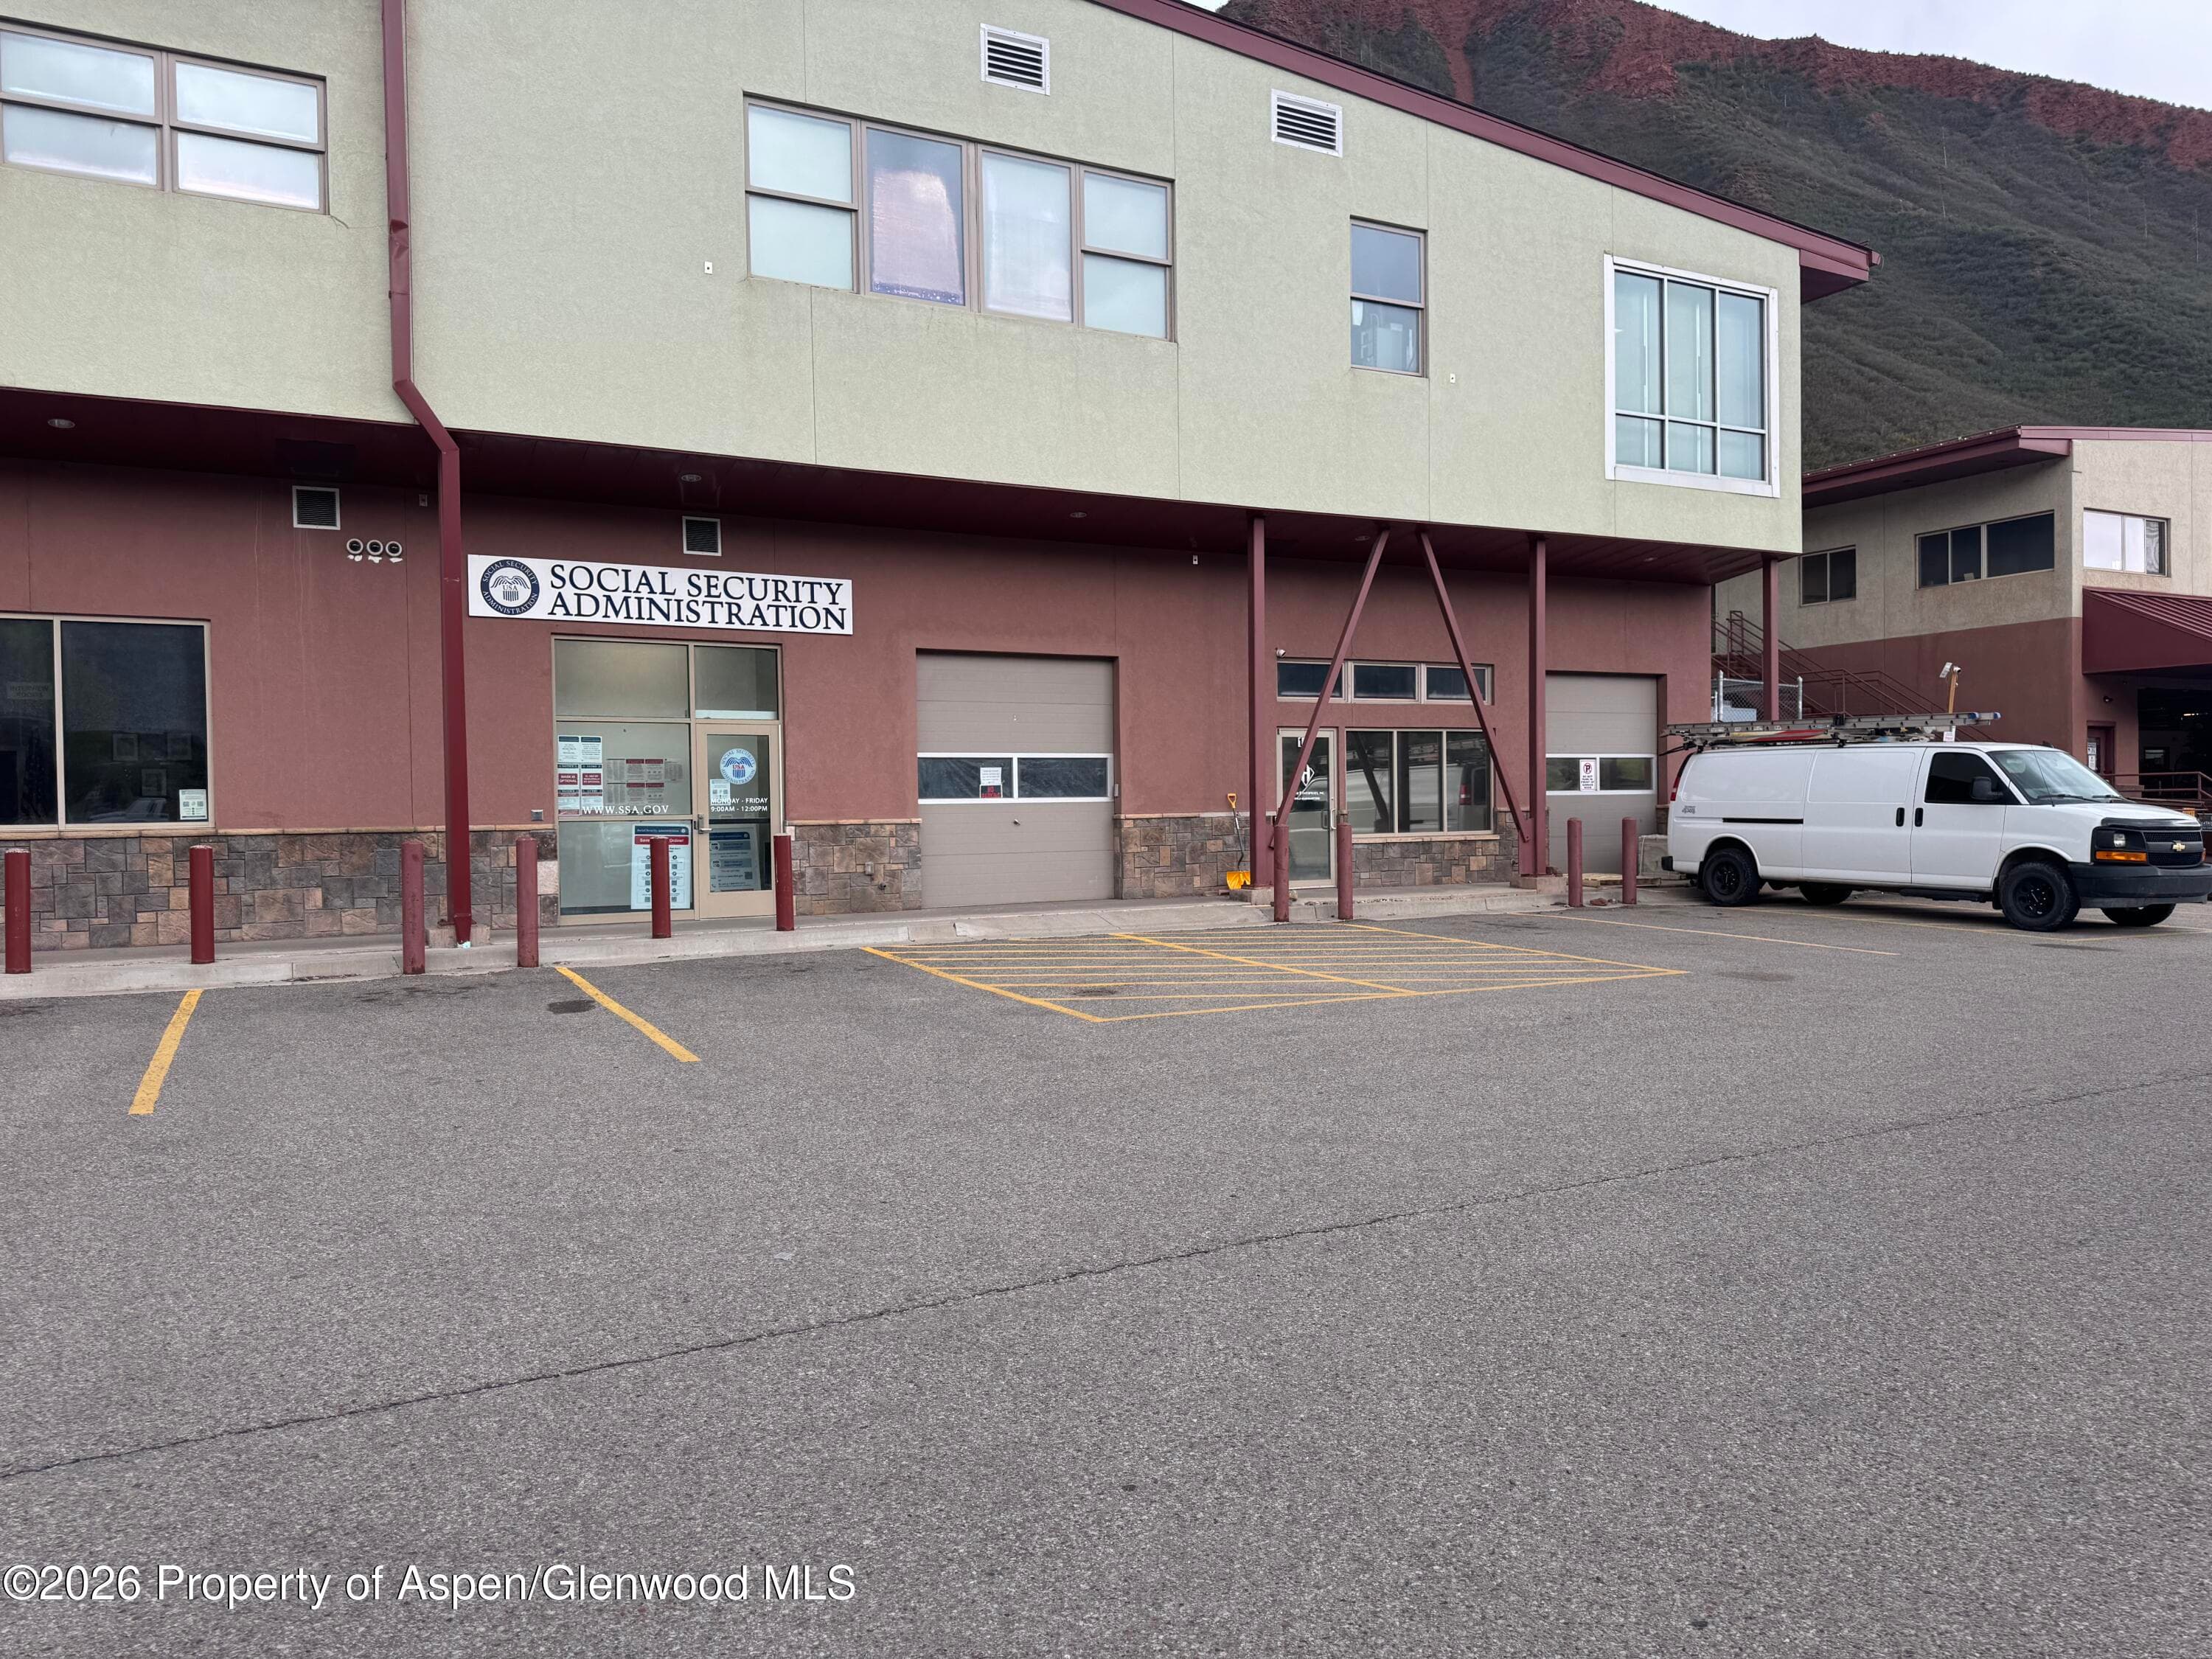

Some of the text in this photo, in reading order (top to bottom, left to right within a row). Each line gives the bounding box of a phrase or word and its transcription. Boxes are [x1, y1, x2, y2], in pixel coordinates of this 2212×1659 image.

[483, 560, 538, 585] SOCIAL SECURITY
[550, 564, 844, 605] SOCIAL SECURITY
[483, 590, 538, 614] ADMINISTRATION
[547, 591, 846, 630] ADMINISTRATION
[582, 805, 669, 815] WWW.SSA.GOV
